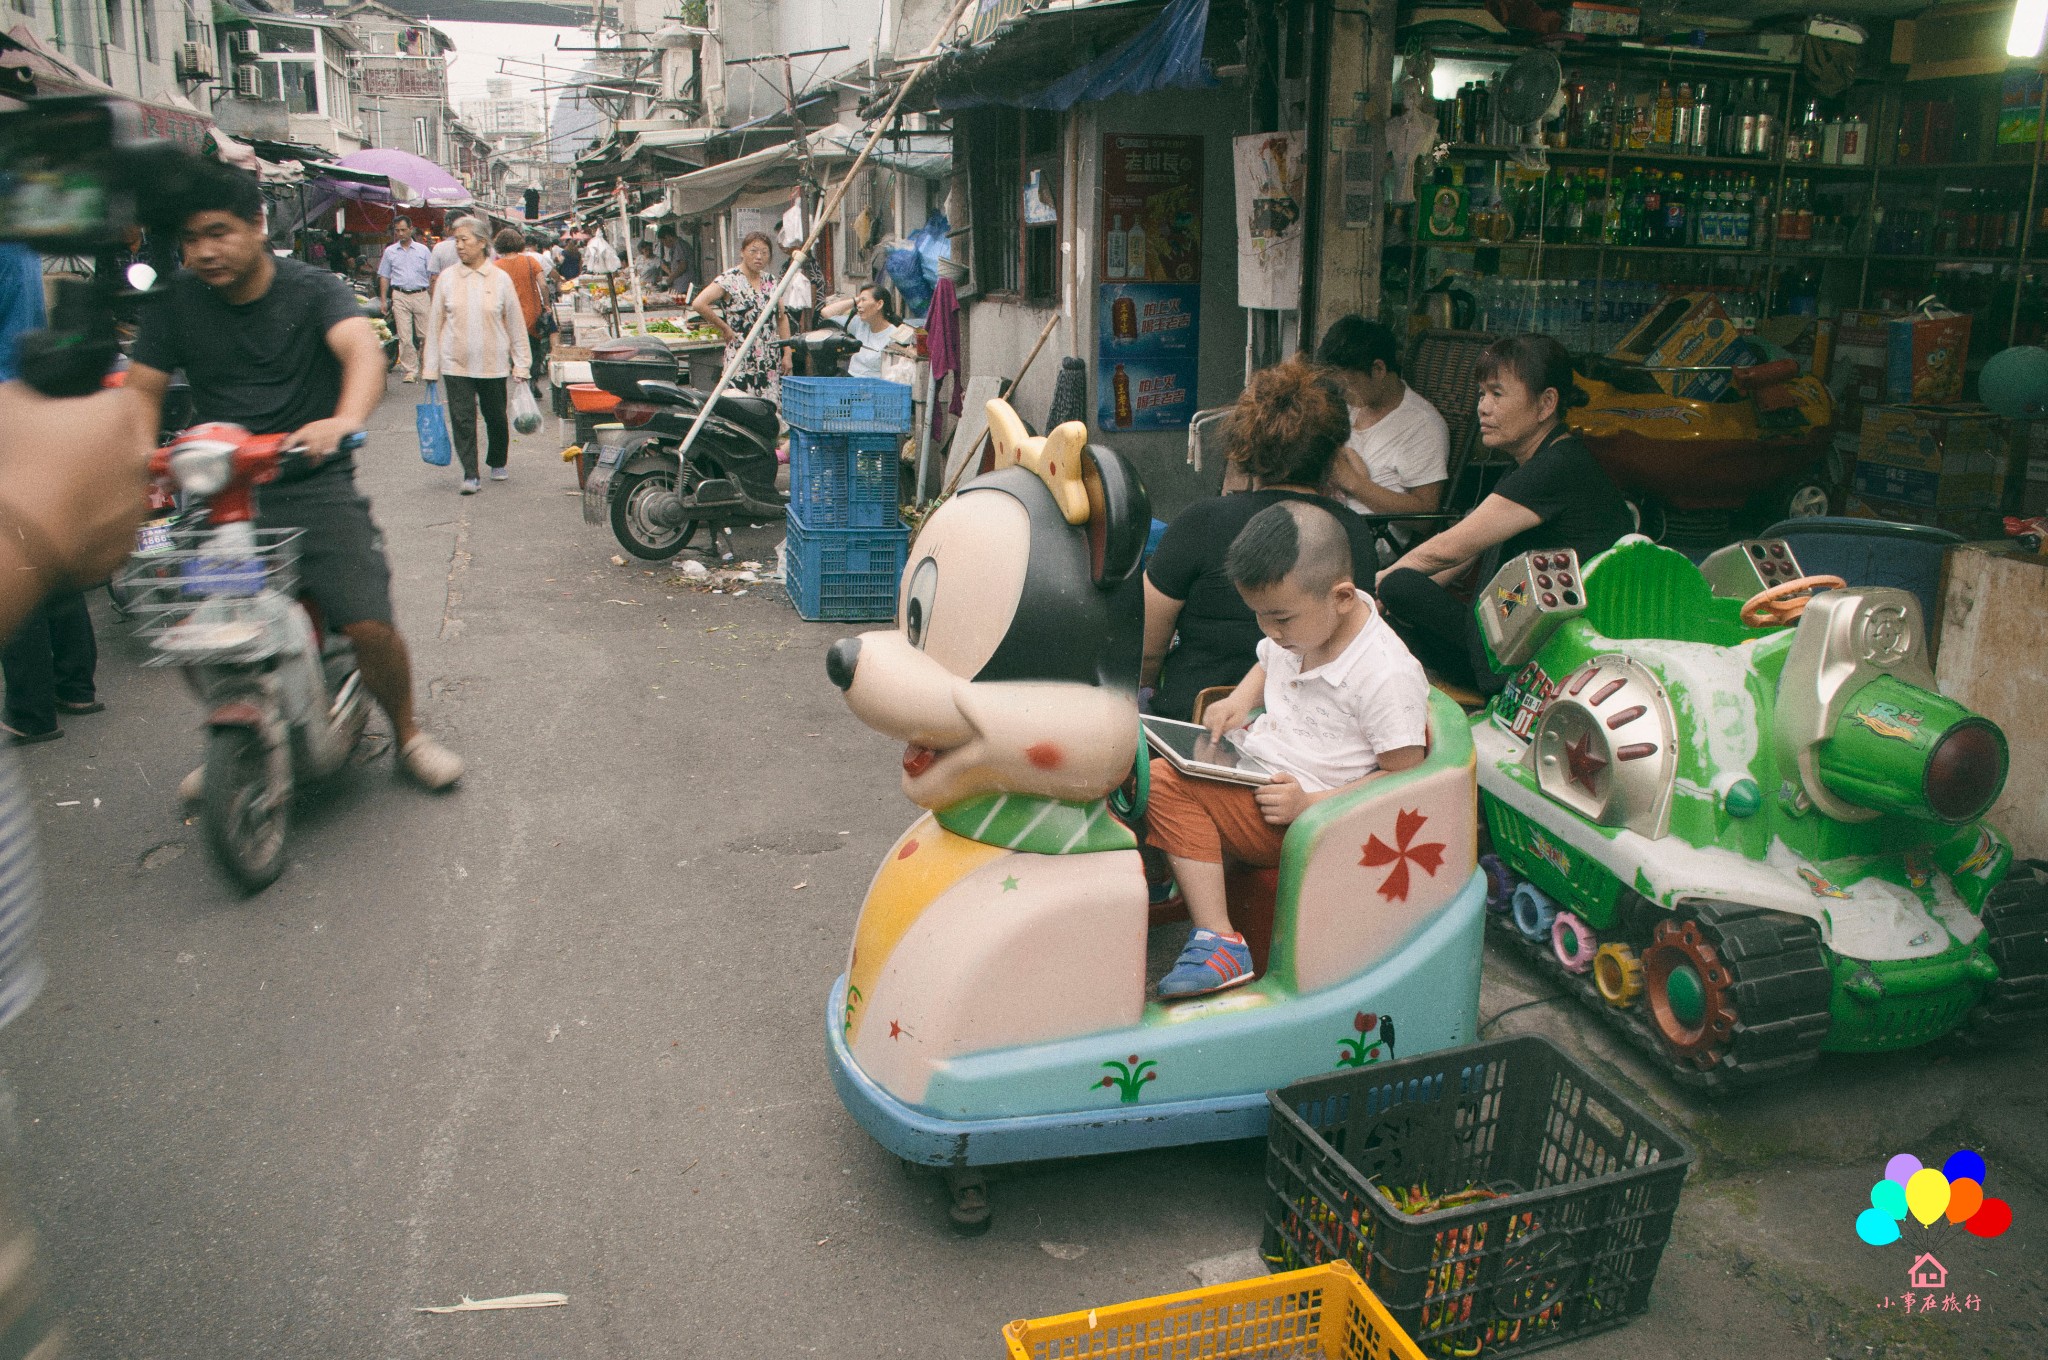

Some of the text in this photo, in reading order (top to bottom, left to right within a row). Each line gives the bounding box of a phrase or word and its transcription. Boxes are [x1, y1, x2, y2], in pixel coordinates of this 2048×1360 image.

[1143, 297, 1181, 317] 怕上火
[1141, 312, 1191, 333] 喝王老吉
[1138, 374, 1176, 393] 怕上火
[1136, 388, 1186, 410] 喝王老吉
[1517, 660, 1554, 700] GTR
[1513, 709, 1534, 735] 01
